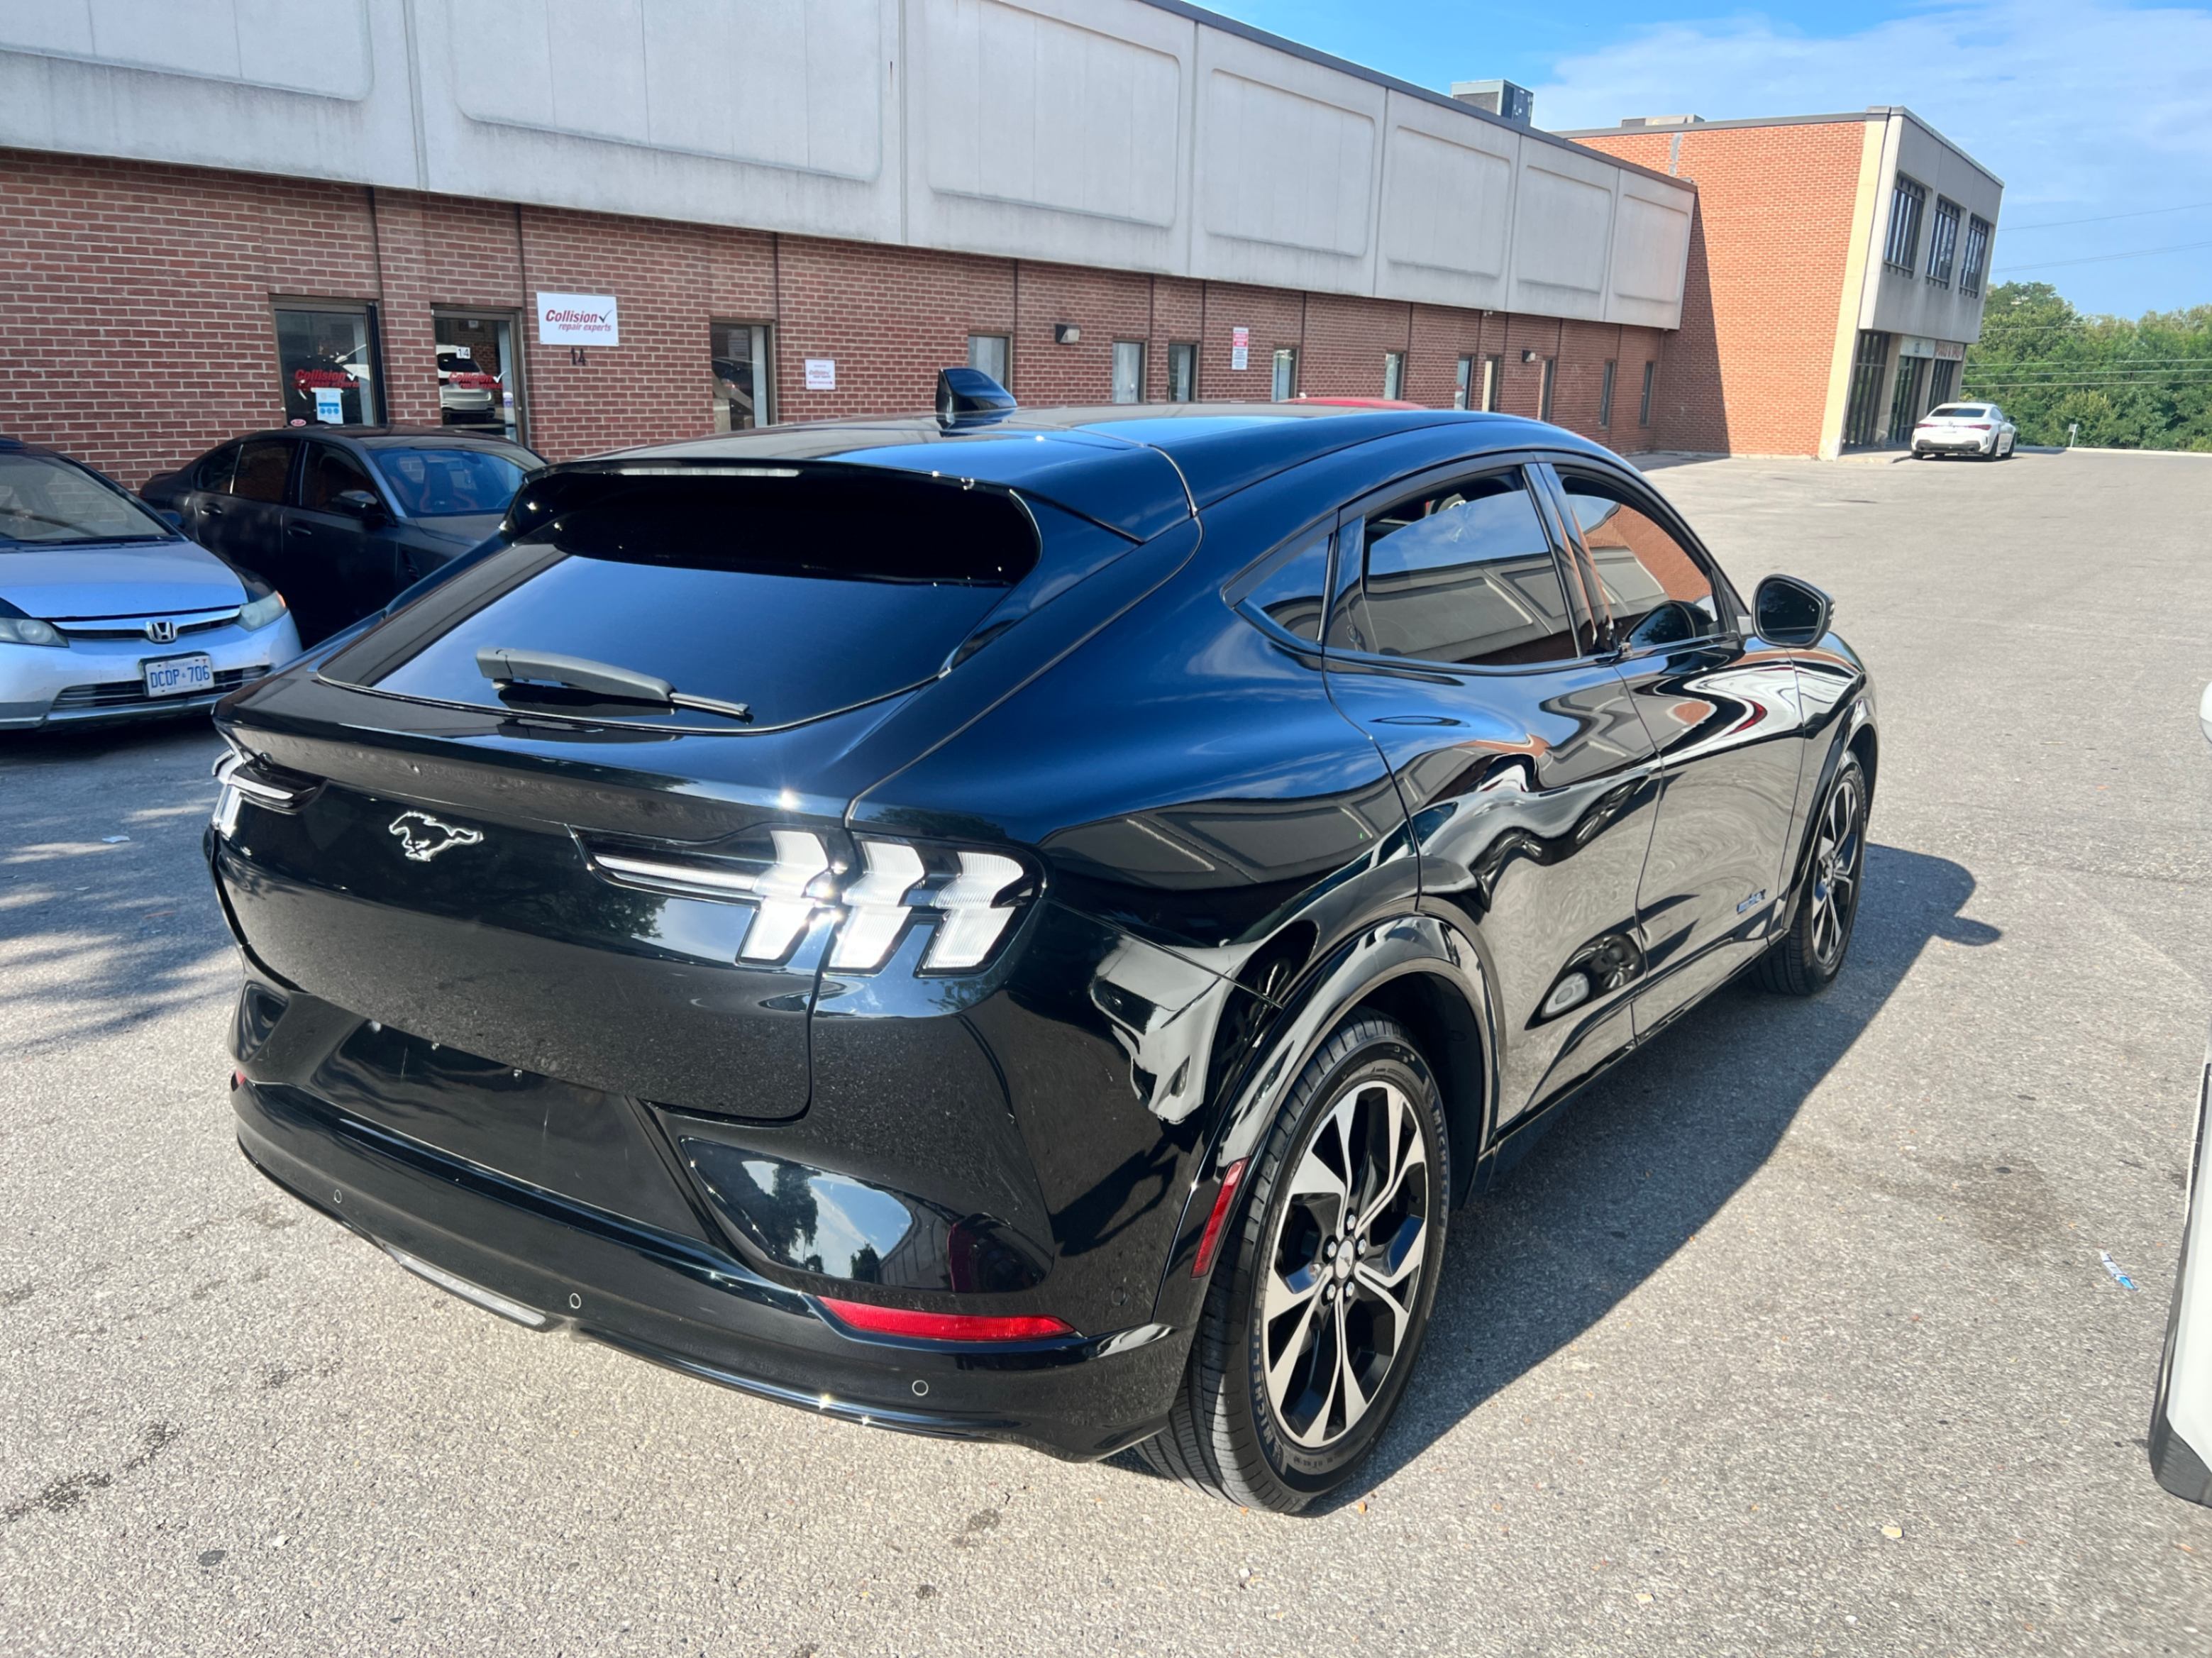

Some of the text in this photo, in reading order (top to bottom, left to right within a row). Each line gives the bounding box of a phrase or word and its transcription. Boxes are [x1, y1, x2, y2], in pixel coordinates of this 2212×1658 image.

[546, 309, 597, 323] Collision
[558, 323, 582, 332] repair
[458, 348, 468, 357] 14
[570, 348, 586, 366] 14
[150, 665, 210, 688] DCDP 706
